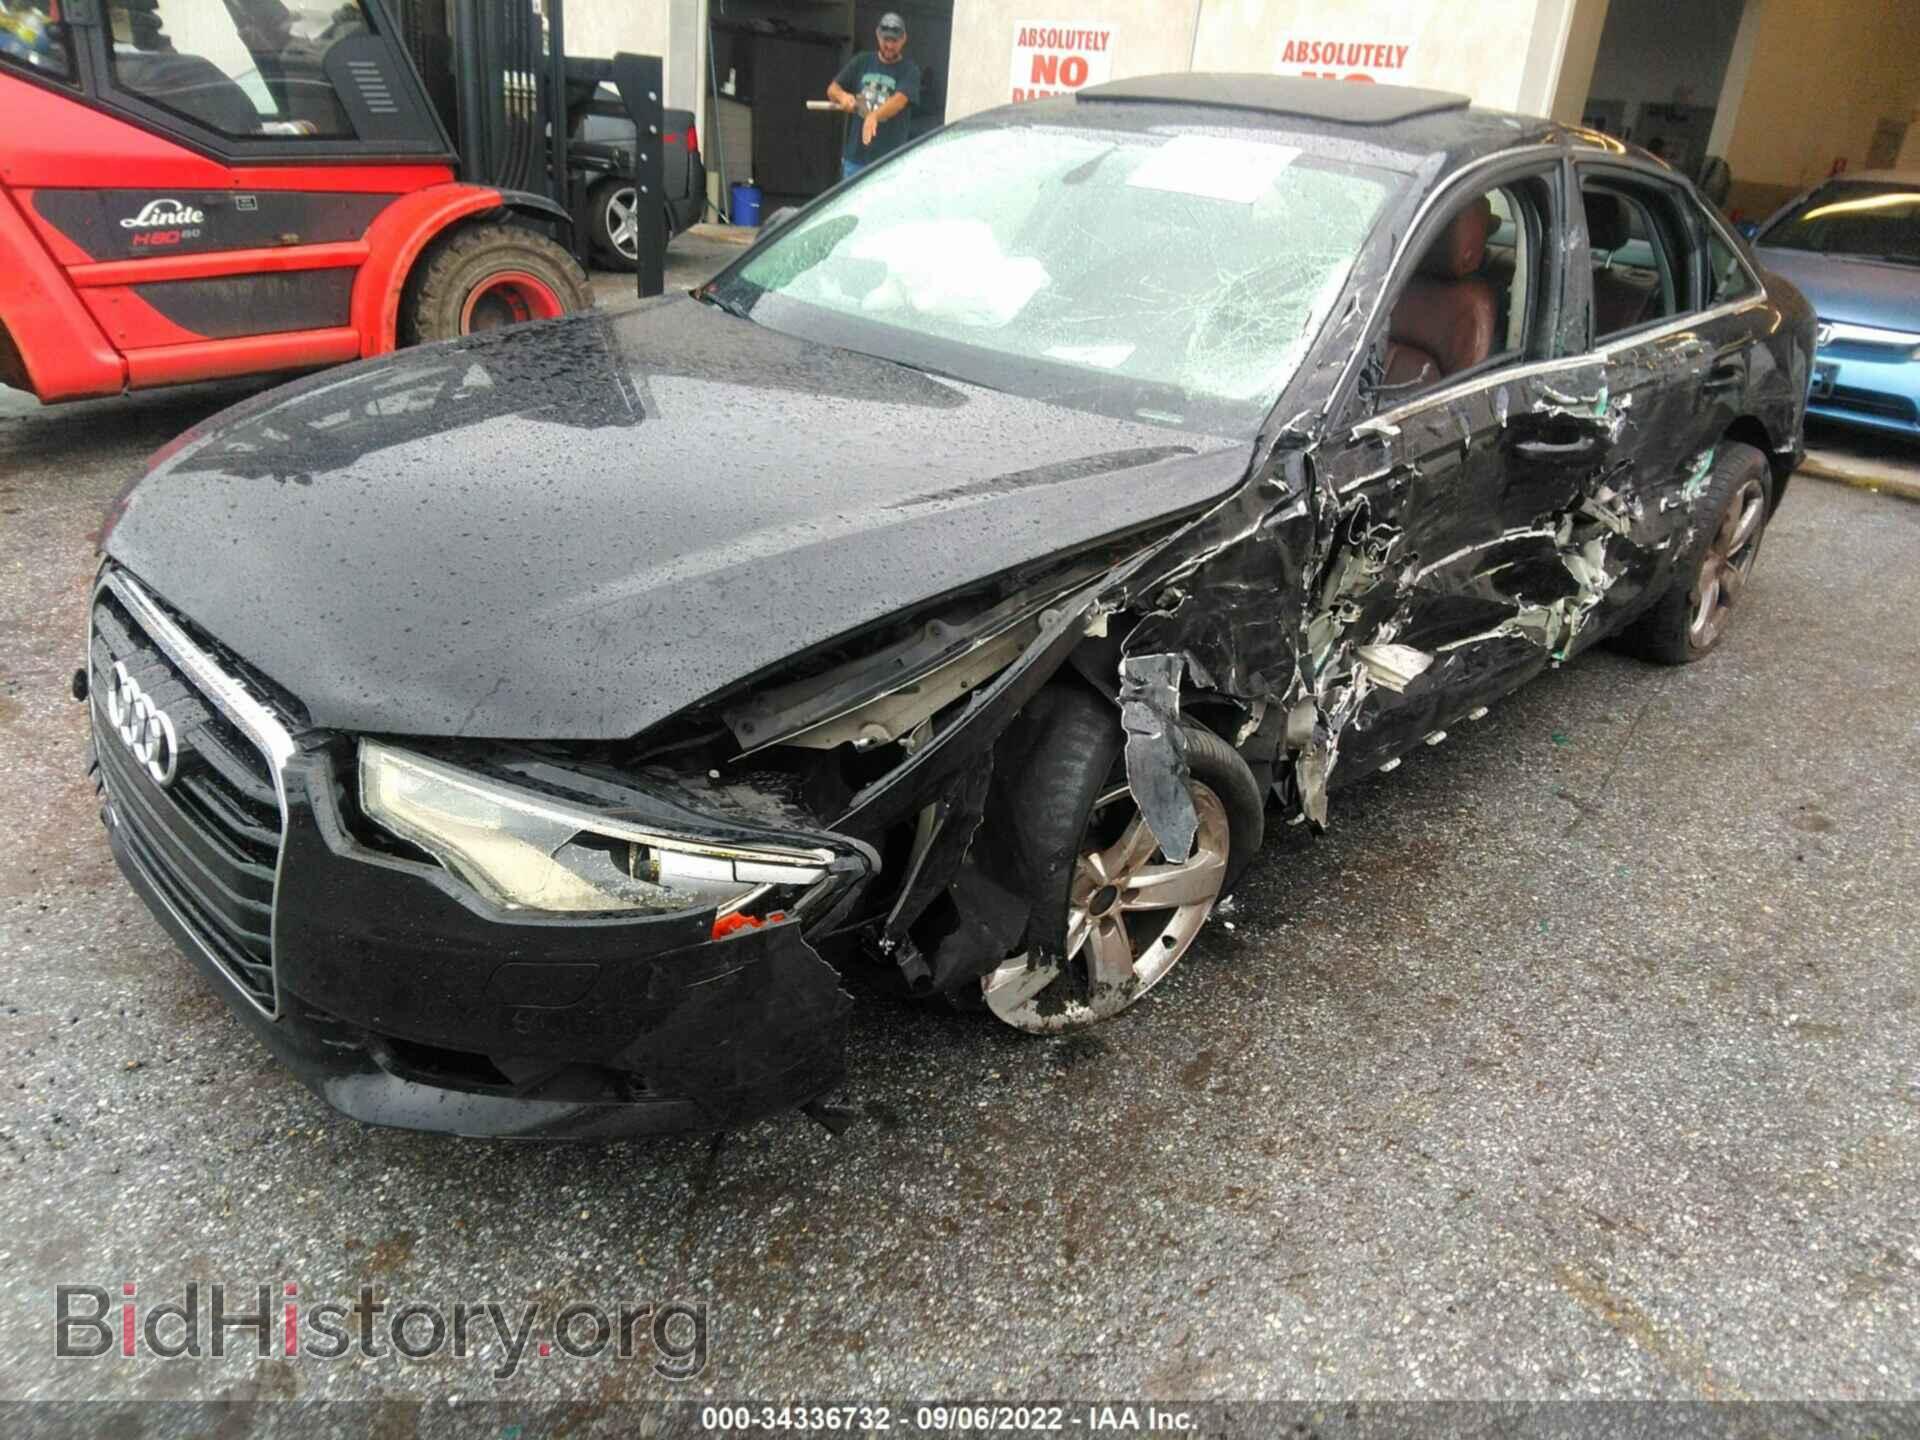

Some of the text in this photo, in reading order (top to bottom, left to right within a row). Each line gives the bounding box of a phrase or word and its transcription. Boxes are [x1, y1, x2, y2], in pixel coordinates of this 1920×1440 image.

[1017, 27, 1110, 51] ABSOLUTELY
[1281, 40, 1408, 68] ABSOLUTELY
[1031, 54, 1088, 87] NO
[120, 198, 204, 228] Linde
